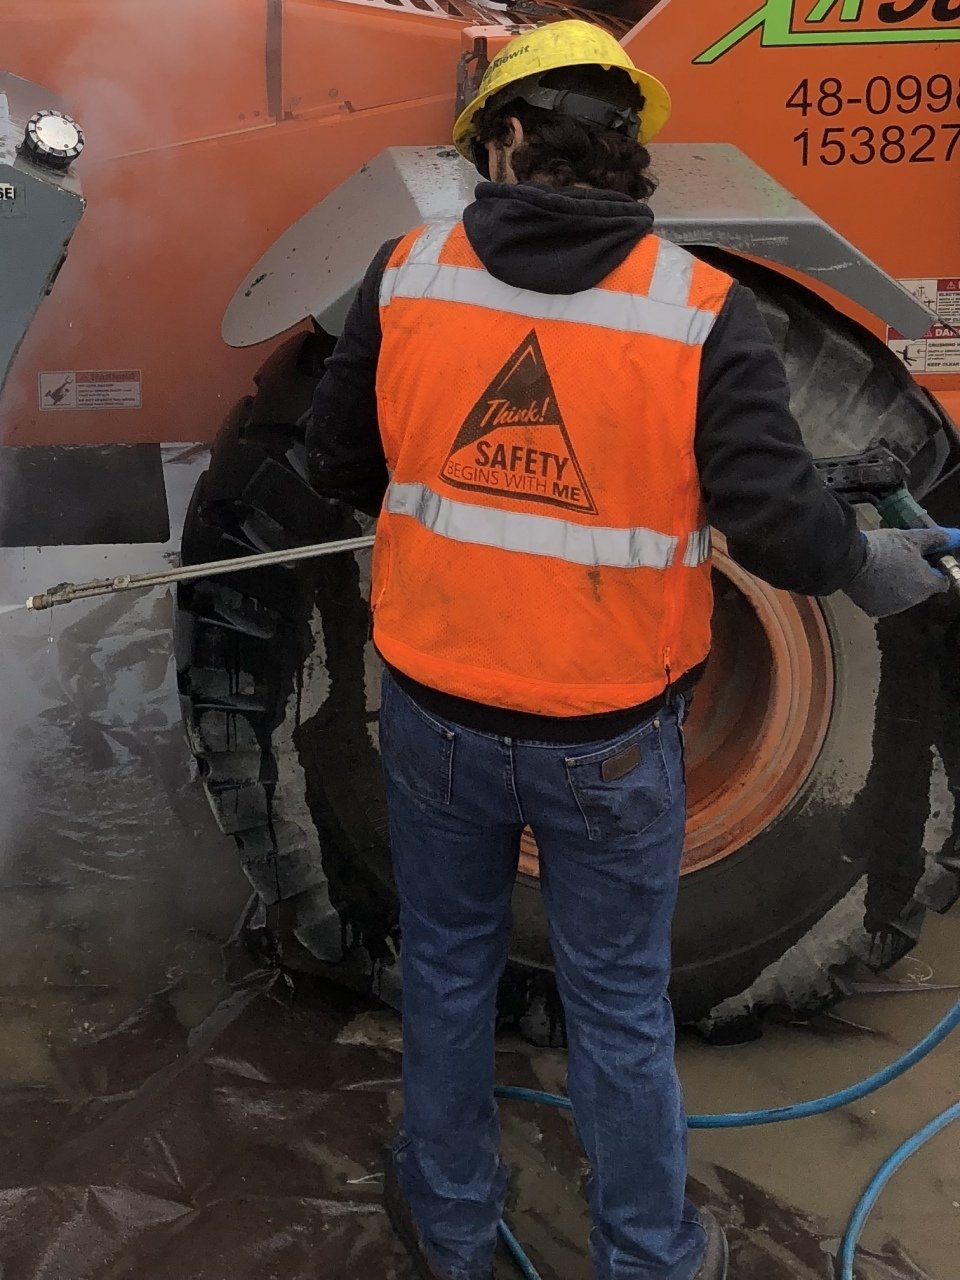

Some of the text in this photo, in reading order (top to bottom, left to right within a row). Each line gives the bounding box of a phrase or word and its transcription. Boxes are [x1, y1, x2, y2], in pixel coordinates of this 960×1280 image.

[785, 73, 960, 117] 48-099
[480, 397, 549, 428] Think!
[447, 460, 581, 502] BEGINS WITH ME
[474, 440, 569, 481] SAFETY
